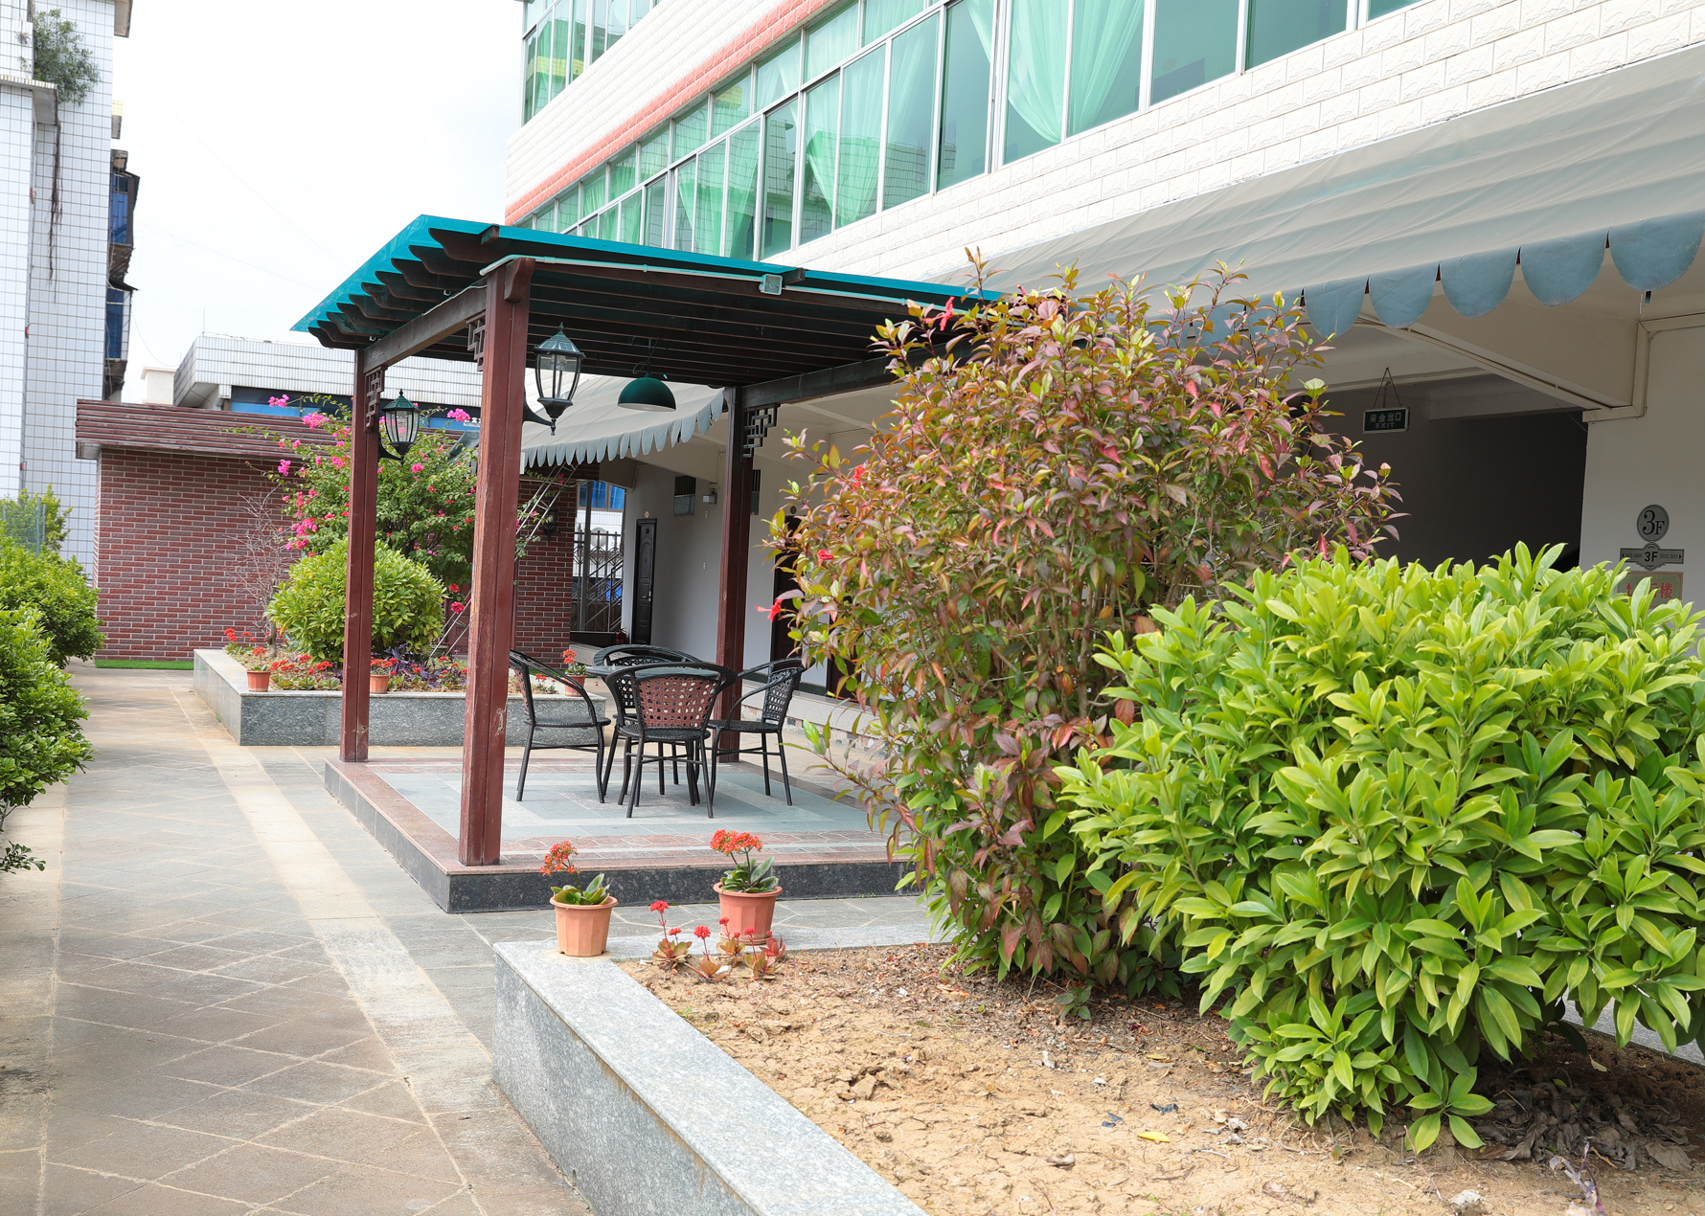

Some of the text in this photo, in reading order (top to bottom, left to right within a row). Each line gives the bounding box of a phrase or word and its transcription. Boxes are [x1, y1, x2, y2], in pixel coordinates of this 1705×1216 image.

[1370, 412, 1402, 423] 安全出口
[1642, 510, 1665, 535] 3F
[1644, 551, 1658, 562] 3F
